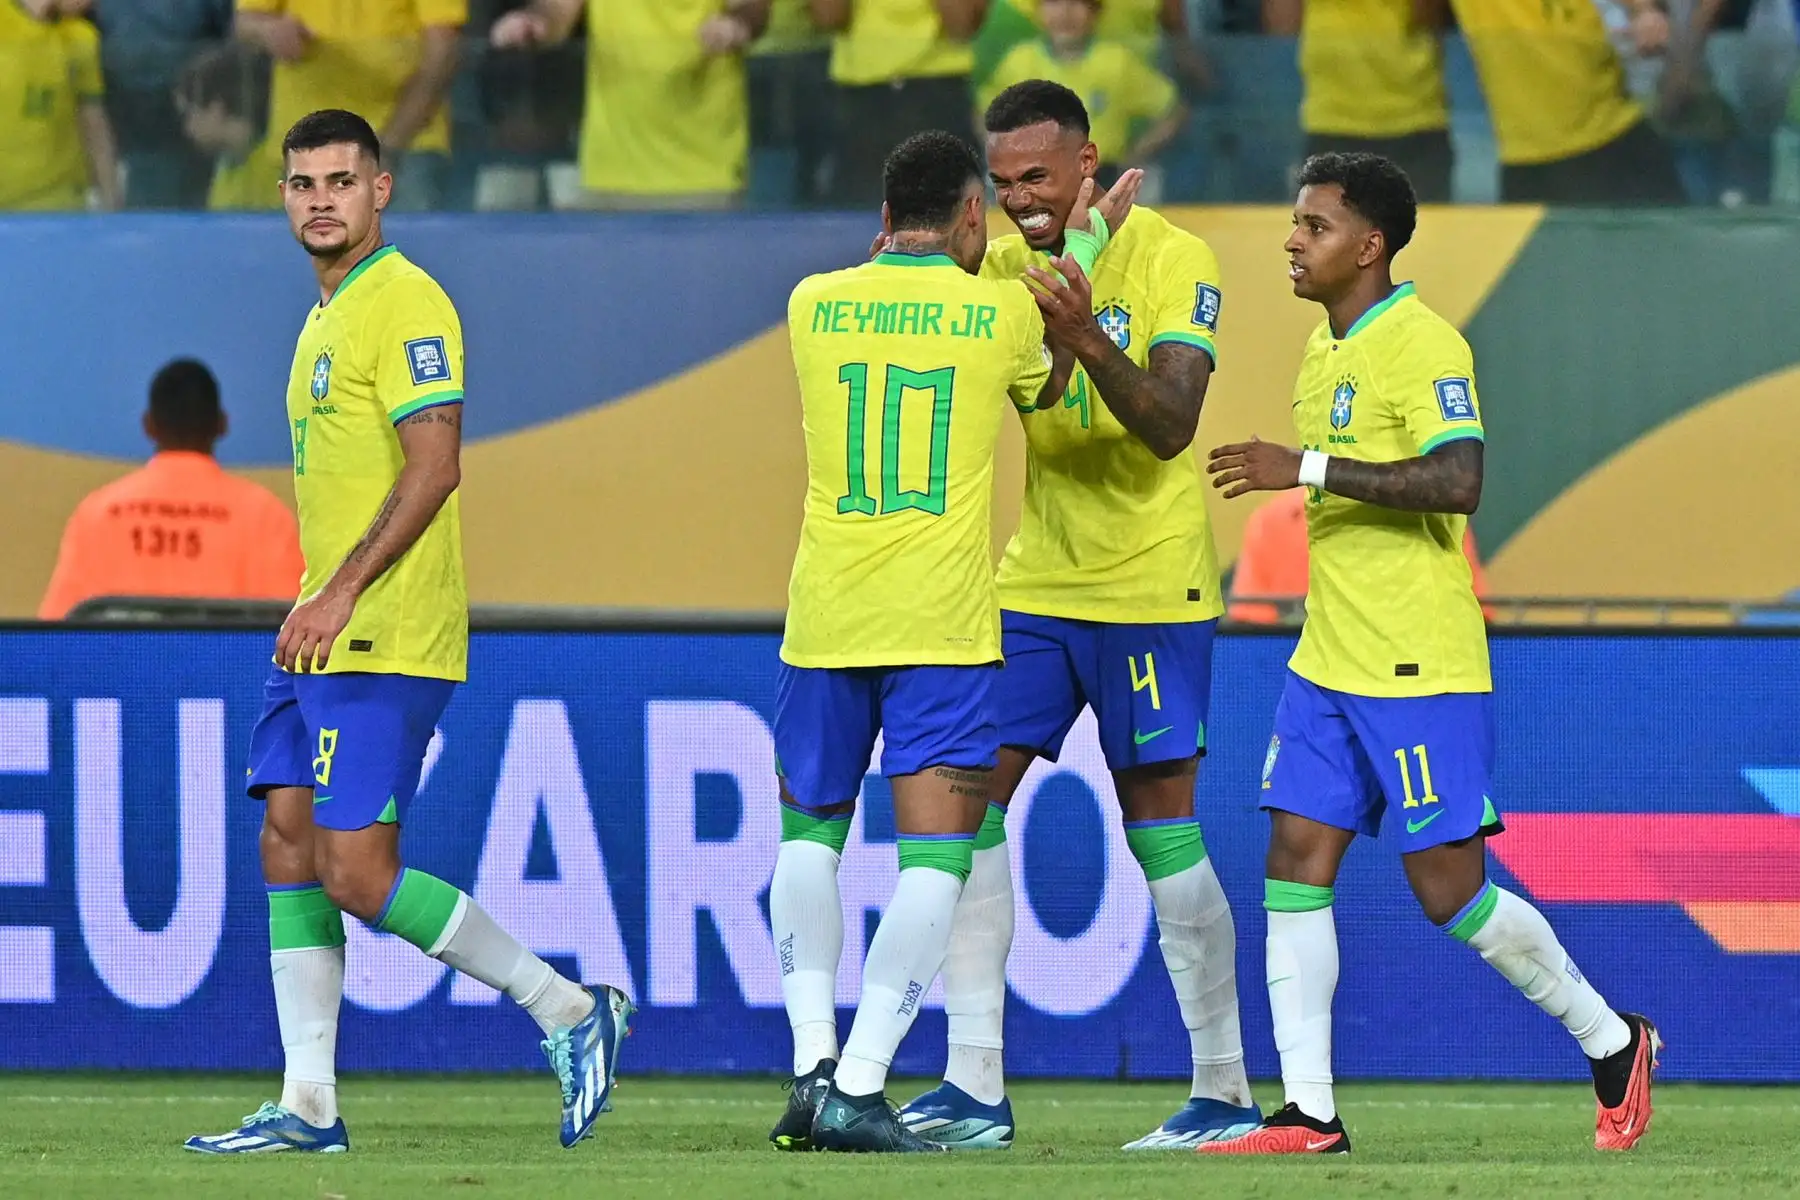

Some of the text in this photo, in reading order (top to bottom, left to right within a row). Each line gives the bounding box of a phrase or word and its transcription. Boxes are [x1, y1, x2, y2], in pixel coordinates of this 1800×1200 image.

[812, 300, 997, 339] NEYMAR JR
[1063, 371, 1089, 429] 4
[294, 417, 307, 476] 8
[837, 362, 956, 516] 10
[1328, 434, 1358, 444] BRASIL
[1127, 652, 1161, 711] 4
[312, 727, 339, 787] 8
[1394, 744, 1439, 809] 11
[342, 697, 1154, 1016] ARO
[779, 932, 795, 976] BRASIL
[897, 980, 923, 1016] BRASIL
